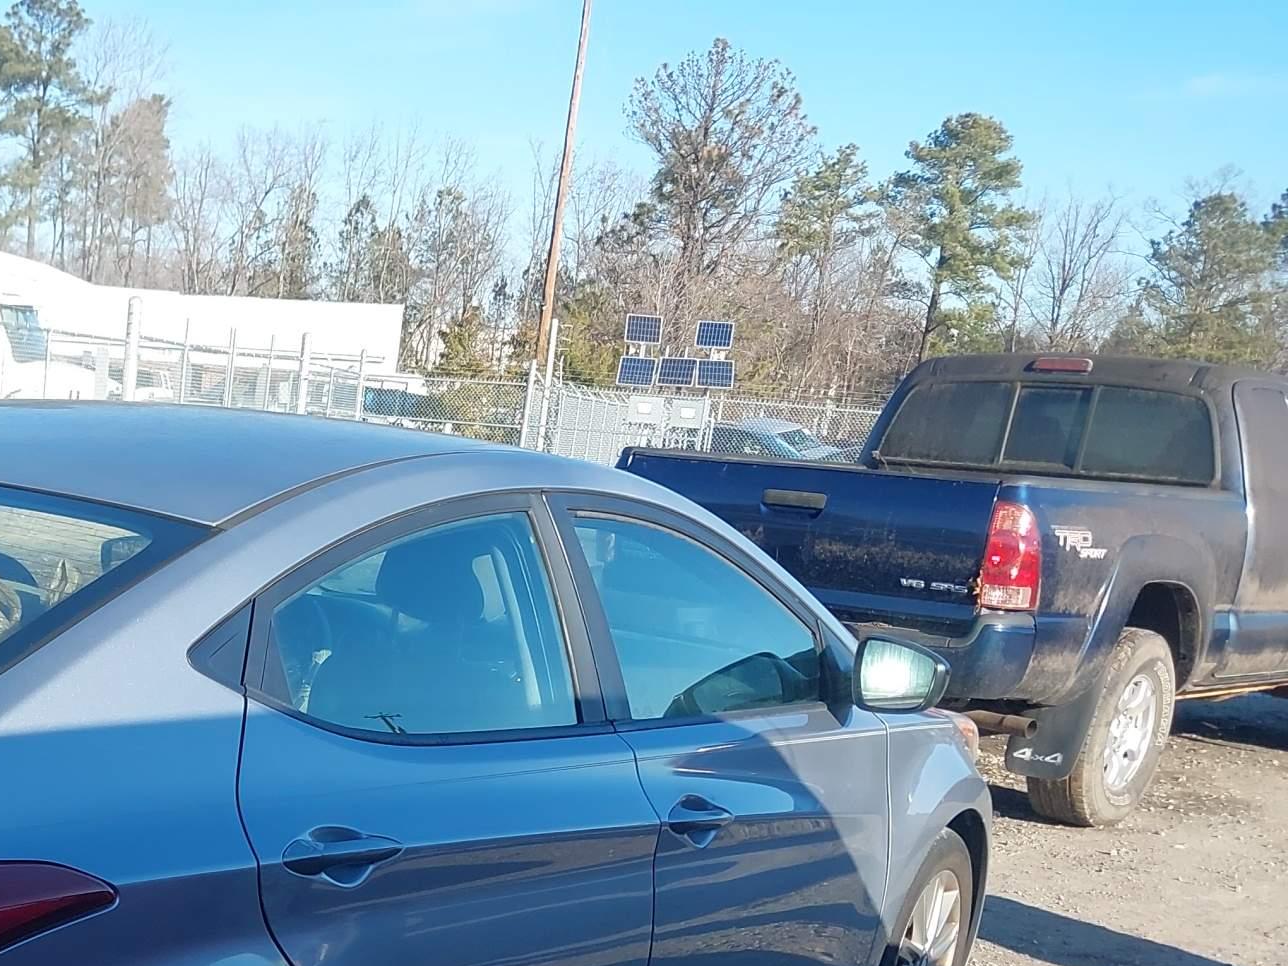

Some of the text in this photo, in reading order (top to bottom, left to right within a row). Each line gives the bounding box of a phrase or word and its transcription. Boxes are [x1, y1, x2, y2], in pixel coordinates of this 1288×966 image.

[1054, 529, 1093, 551] TRD
[1079, 548, 1108, 559] SPORT
[899, 578, 925, 589] V6
[1013, 748, 1064, 766] 4x4
